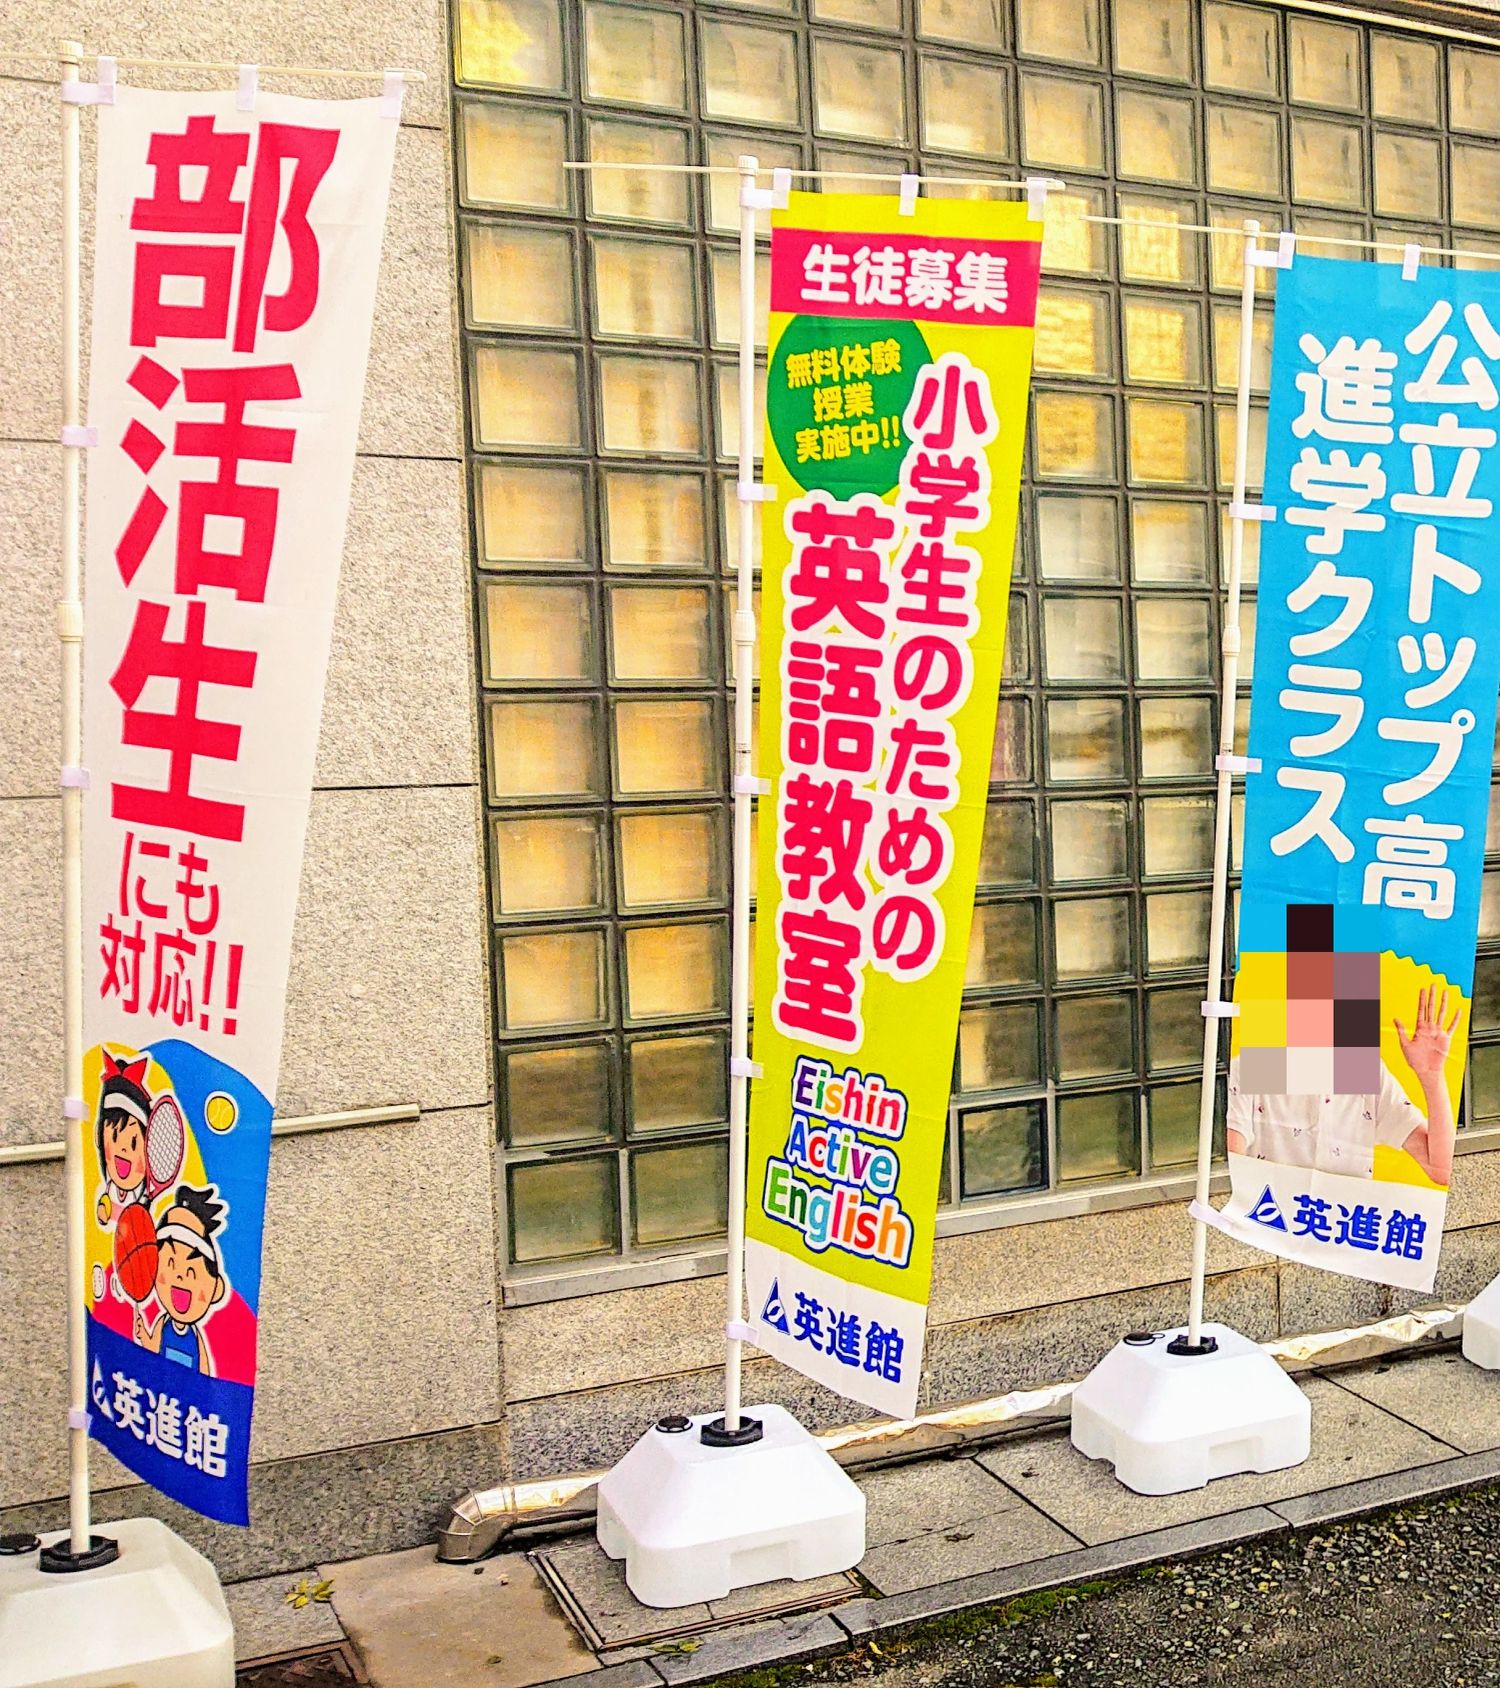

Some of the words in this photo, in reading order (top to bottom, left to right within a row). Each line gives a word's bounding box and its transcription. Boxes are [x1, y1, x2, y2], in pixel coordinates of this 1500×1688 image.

[800, 243, 1009, 314] 生徒募集
[785, 338, 902, 389] 無料体験
[812, 381, 875, 422] 授業
[109, 114, 341, 842] 部活生
[1270, 333, 1398, 864] 進学クラス
[872, 364, 988, 971] 小学生のための
[779, 501, 896, 1044] 英語教室
[118, 829, 220, 933] にも
[794, 1063, 903, 1132] Eishin
[787, 1119, 894, 1190] Active
[766, 1165, 910, 1260] English
[1293, 1194, 1427, 1261] 英進館
[794, 1291, 905, 1384] 英進館
[111, 1371, 229, 1478] 英進館
